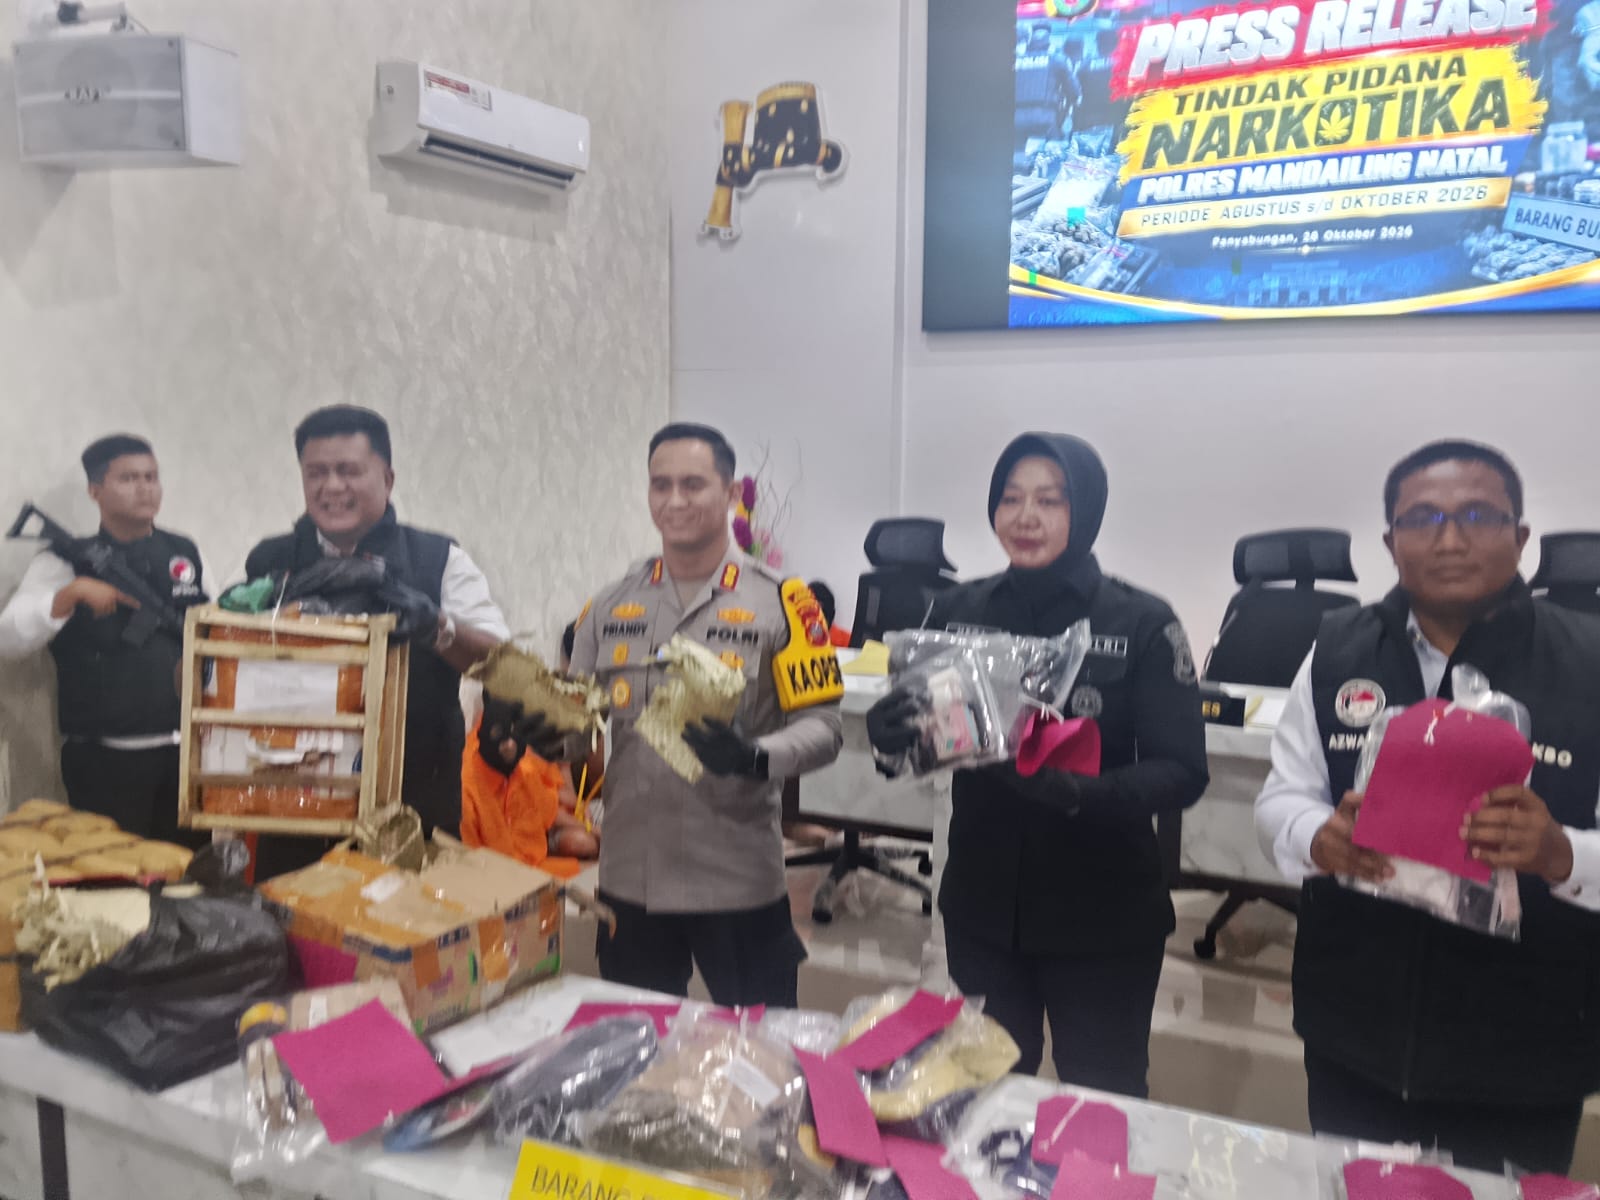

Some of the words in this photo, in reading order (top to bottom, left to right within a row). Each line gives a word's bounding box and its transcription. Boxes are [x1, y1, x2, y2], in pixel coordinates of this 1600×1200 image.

[1128, 6, 1300, 80] PRESS
[1304, 0, 1537, 54] RELEASE
[1173, 73, 1312, 115] TINDAK
[1323, 56, 1467, 94] PIDANA
[1142, 77, 1510, 170] NARKOTIKA
[1138, 169, 1237, 203] POLRES
[1238, 152, 1413, 195] MANDAILING
[1415, 146, 1508, 179] NATAL
[1141, 207, 1211, 227] PERIODE
[1220, 201, 1301, 219] AGUSTUS
[1307, 196, 1334, 213] s/d
[1341, 190, 1428, 209] OKTOBER
[1514, 207, 1573, 233] BARANG
[1576, 218, 1600, 241] BU
[1323, 227, 1376, 242] Oktober
[706, 626, 759, 645] POLRI
[1329, 733, 1366, 751] AZWA
